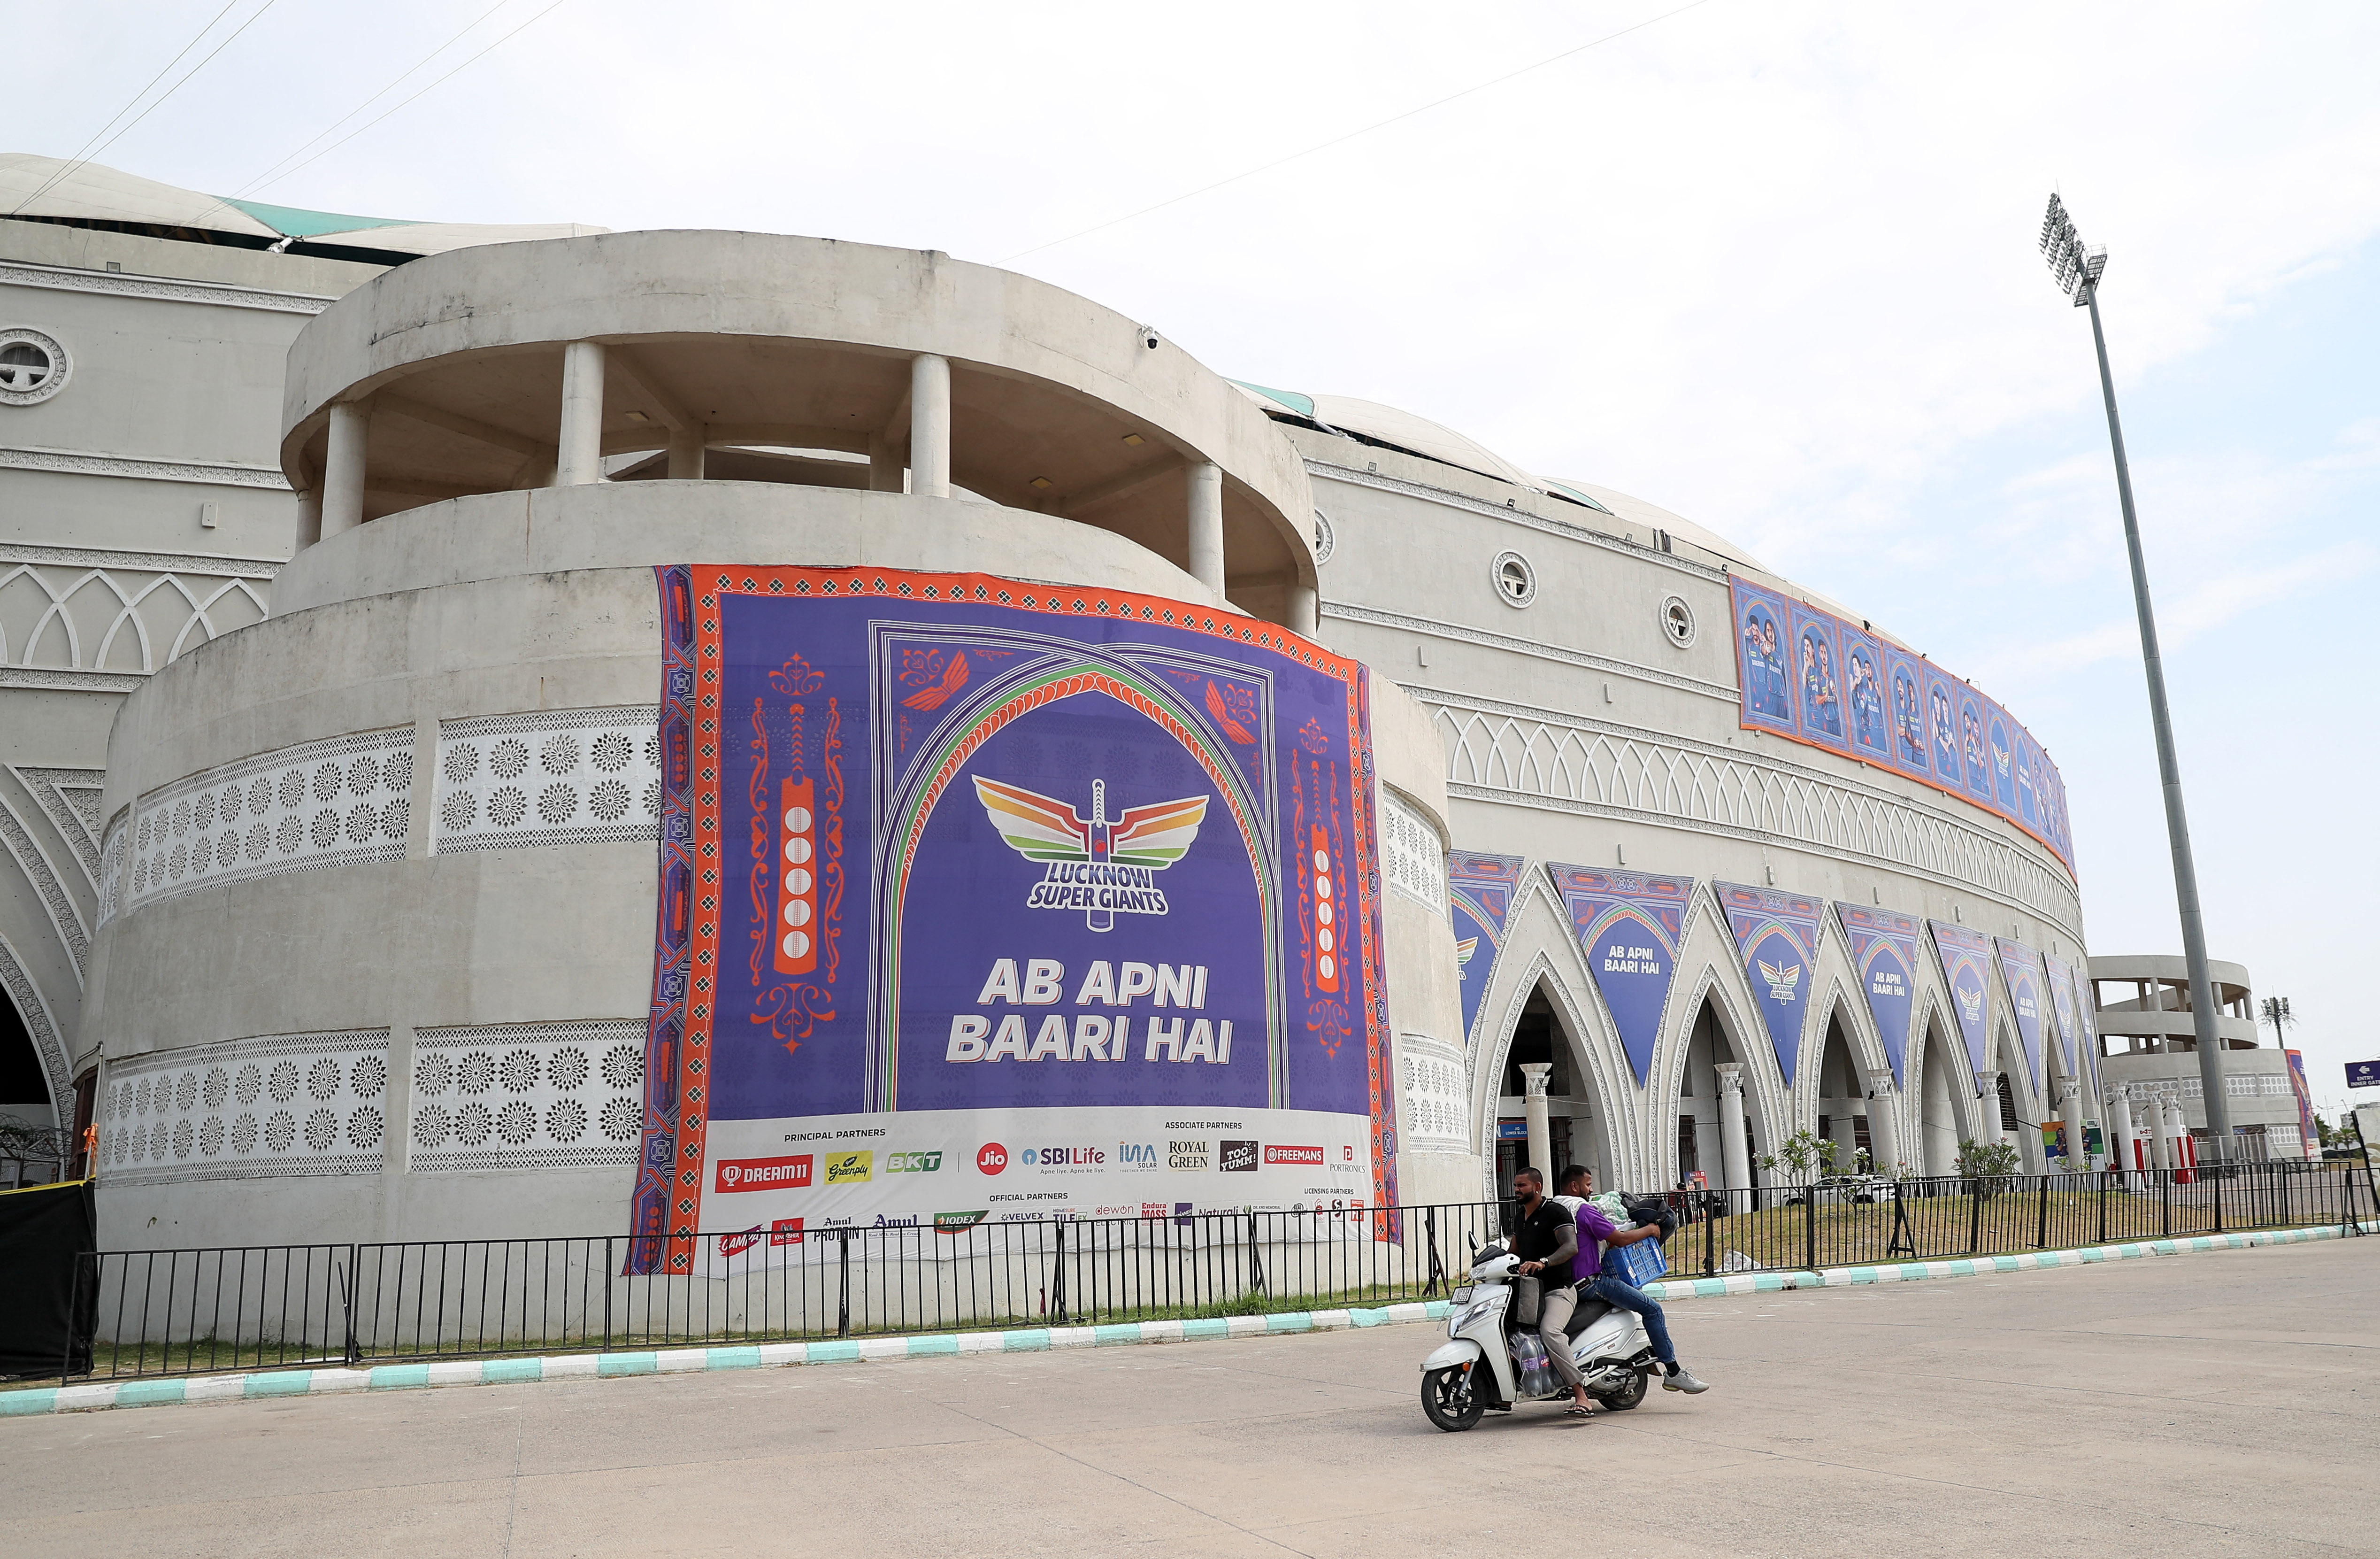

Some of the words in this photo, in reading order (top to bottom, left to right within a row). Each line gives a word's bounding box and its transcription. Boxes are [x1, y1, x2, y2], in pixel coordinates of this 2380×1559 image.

[1048, 862, 1152, 888] LUCKNOW
[1029, 885, 1094, 907] SUPER
[1098, 889, 1167, 912] GIANTS
[1608, 945, 1625, 958] AB
[1627, 947, 1653, 960] APNI
[1604, 959, 1638, 973] BAARI
[1641, 961, 1659, 974] HAI
[976, 958, 1065, 1005] AB
[1075, 960, 1209, 1010] APNI
[1875, 972, 1885, 982] AB
[1886, 973, 1901, 984] APNI
[1873, 983, 1893, 995] BAARI
[1894, 985, 1905, 996] HAI
[945, 1014, 1131, 1063] BAARI
[1144, 1016, 1234, 1065] HAI
[784, 1132, 833, 1142] PRINCIPAL
[836, 1129, 886, 1138] PARTNERS
[1169, 1141, 1210, 1154] ROYAL
[1227, 1147, 1248, 1160] TOO
[887, 1151, 941, 1172] BKT
[980, 1150, 1006, 1165] Jio
[1168, 1155, 1209, 1168] GREEN
[1277, 1150, 1322, 1161] FREEMANS
[1221, 1154, 1257, 1172] YUMM!
[1330, 1163, 1365, 1173] PORTRONICS
[744, 1164, 807, 1183] DREAM11
[829, 1163, 868, 1181] Greenply
[823, 1216, 852, 1227] Amul
[873, 1214, 917, 1228] Amul
[946, 1215, 976, 1225] IODEX
[1141, 1210, 1167, 1220] MASS
[814, 1226, 860, 1243] PROTIN
